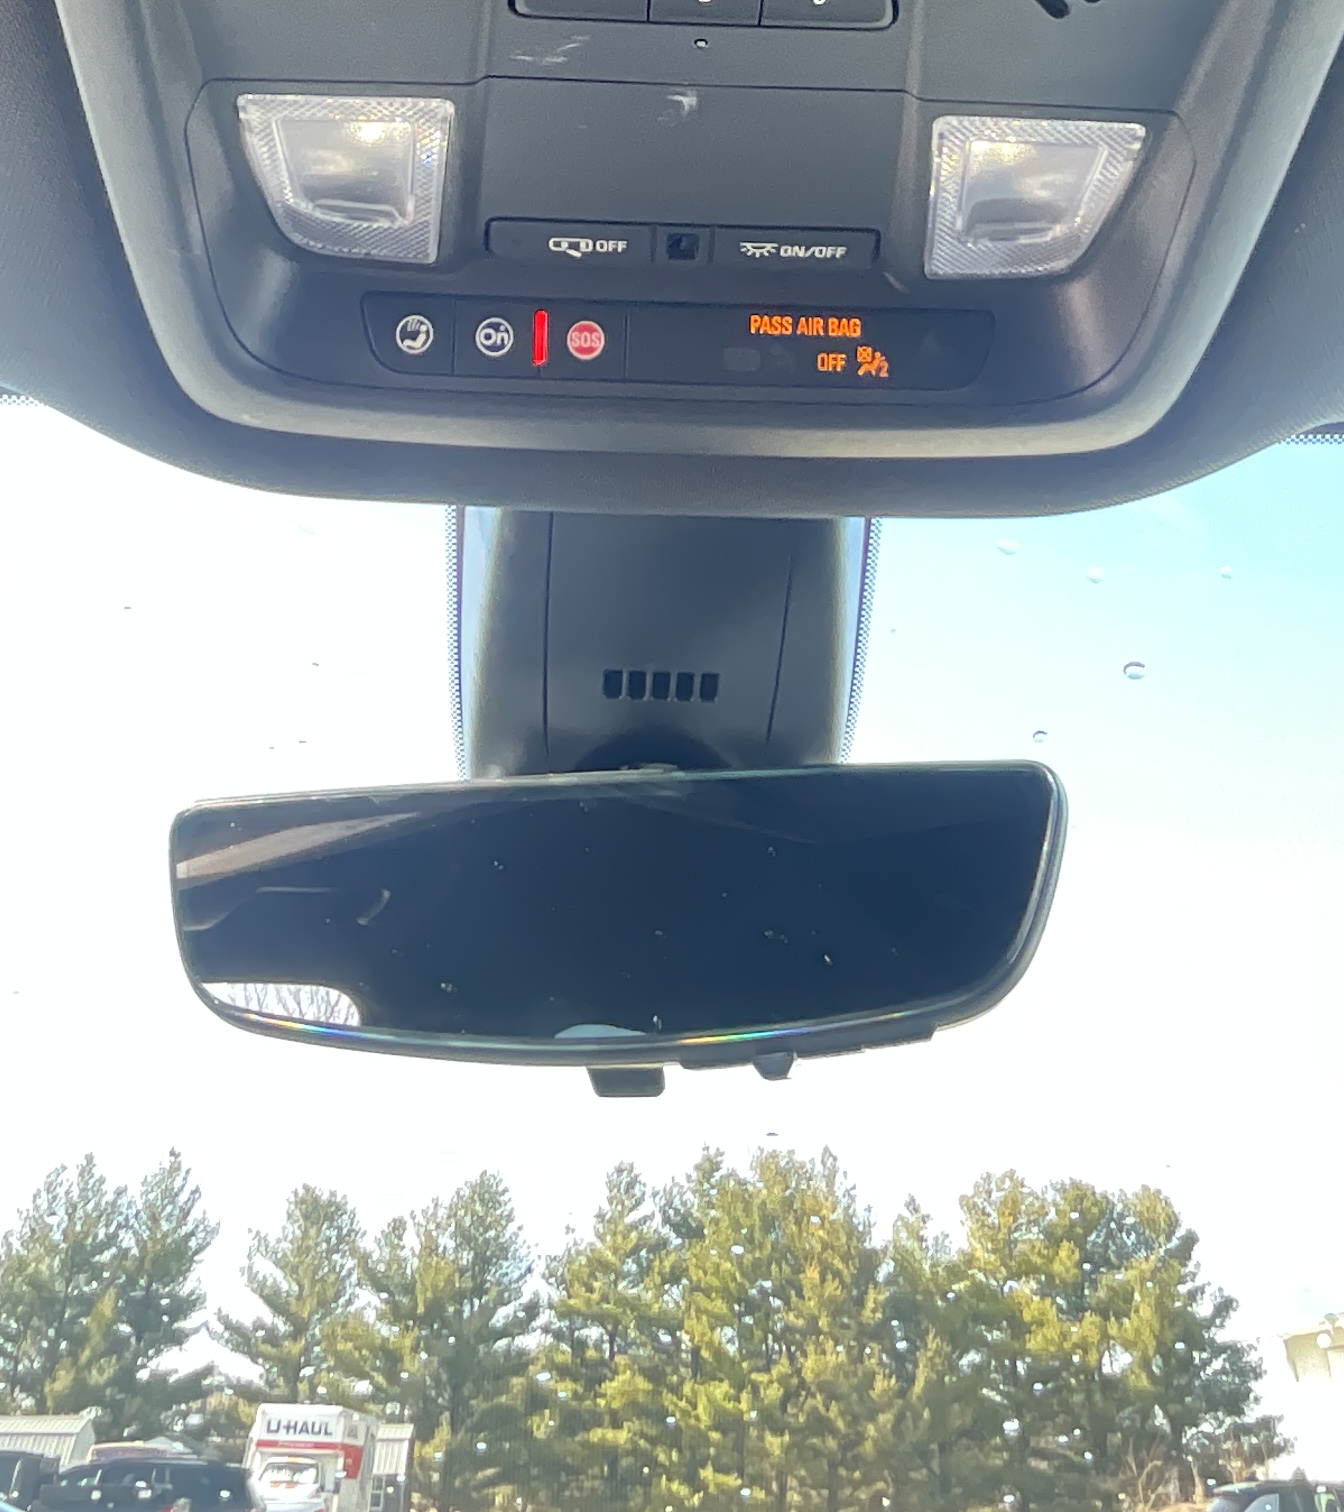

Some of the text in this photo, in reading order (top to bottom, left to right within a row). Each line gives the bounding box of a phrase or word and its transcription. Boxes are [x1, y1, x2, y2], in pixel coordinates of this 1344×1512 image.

[595, 240, 628, 253] OFF
[779, 244, 848, 259] ON/OFF
[749, 314, 862, 338] PASS AIR BAG
[479, 324, 509, 346] On
[570, 331, 602, 348] SOS
[816, 352, 847, 372] OFF
[266, 1419, 333, 1436] U-HAUL
